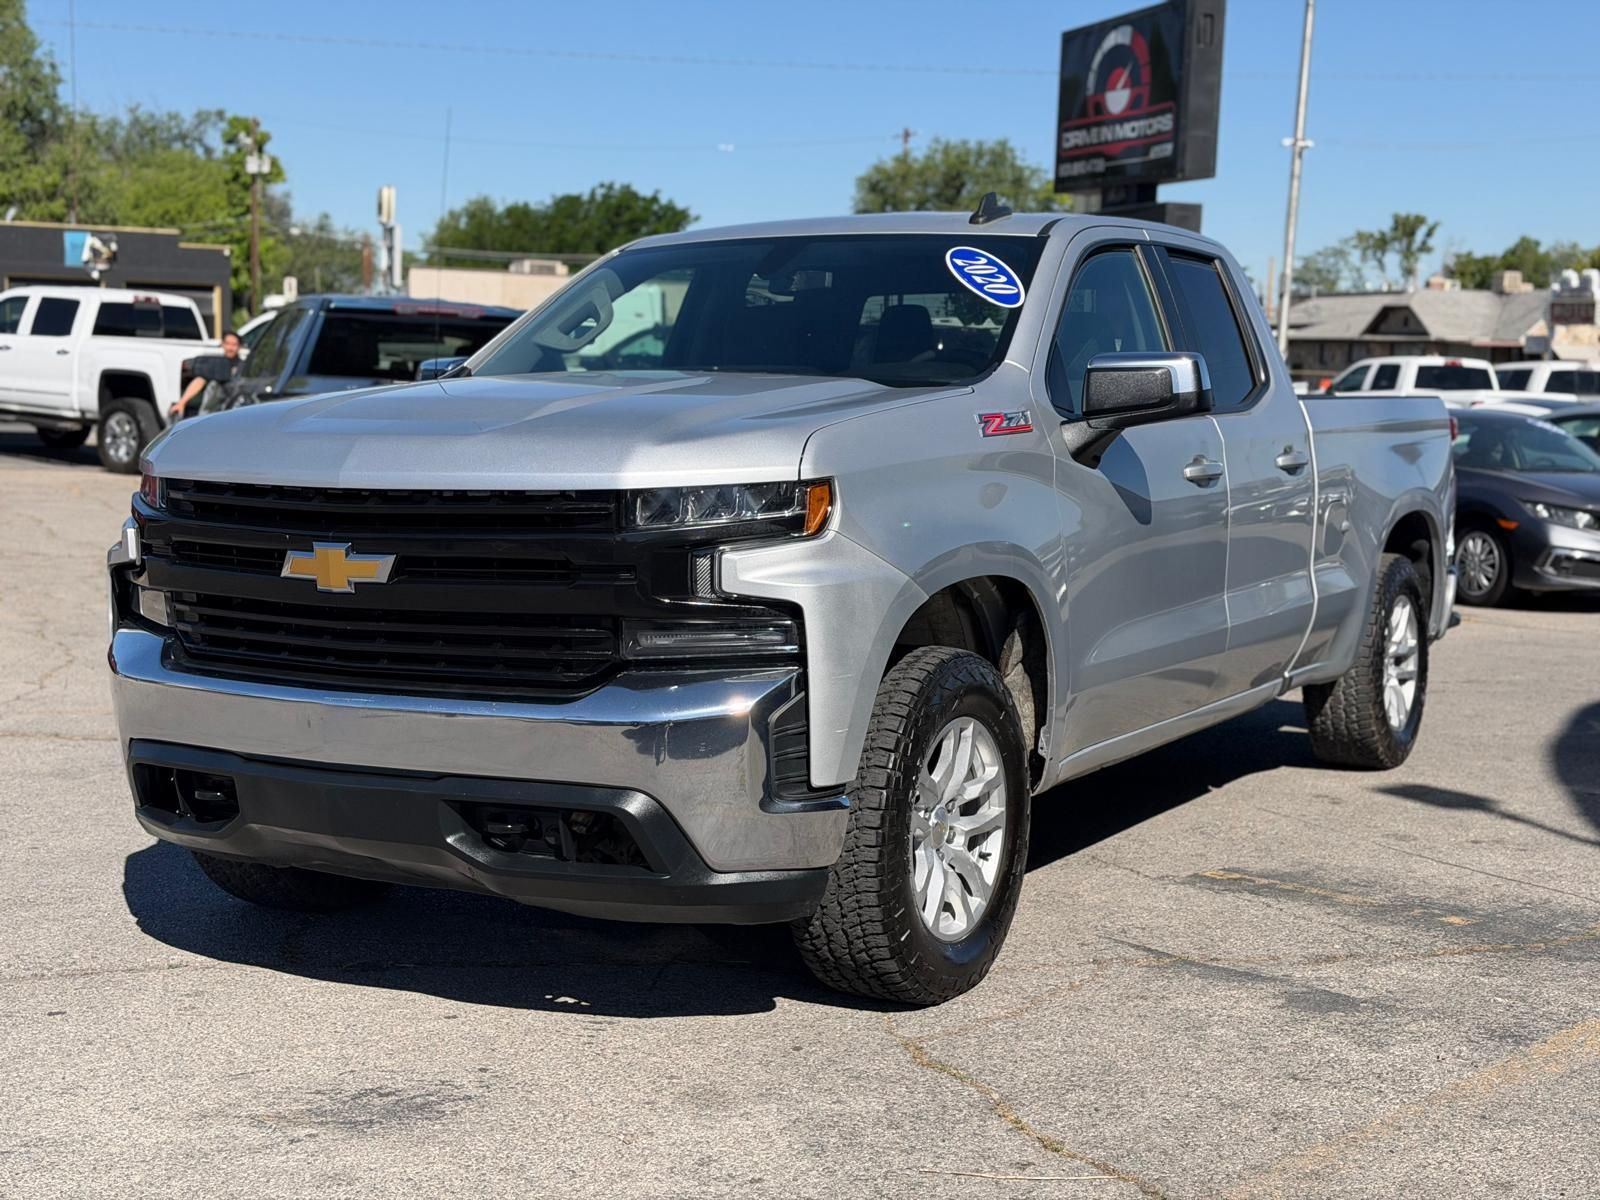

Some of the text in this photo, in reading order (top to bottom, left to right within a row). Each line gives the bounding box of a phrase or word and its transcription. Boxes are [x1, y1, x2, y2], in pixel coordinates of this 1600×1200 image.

[1114, 113, 1174, 140] MOTORS
[952, 256, 1018, 294] 2020
[979, 410, 1034, 437] Z71
